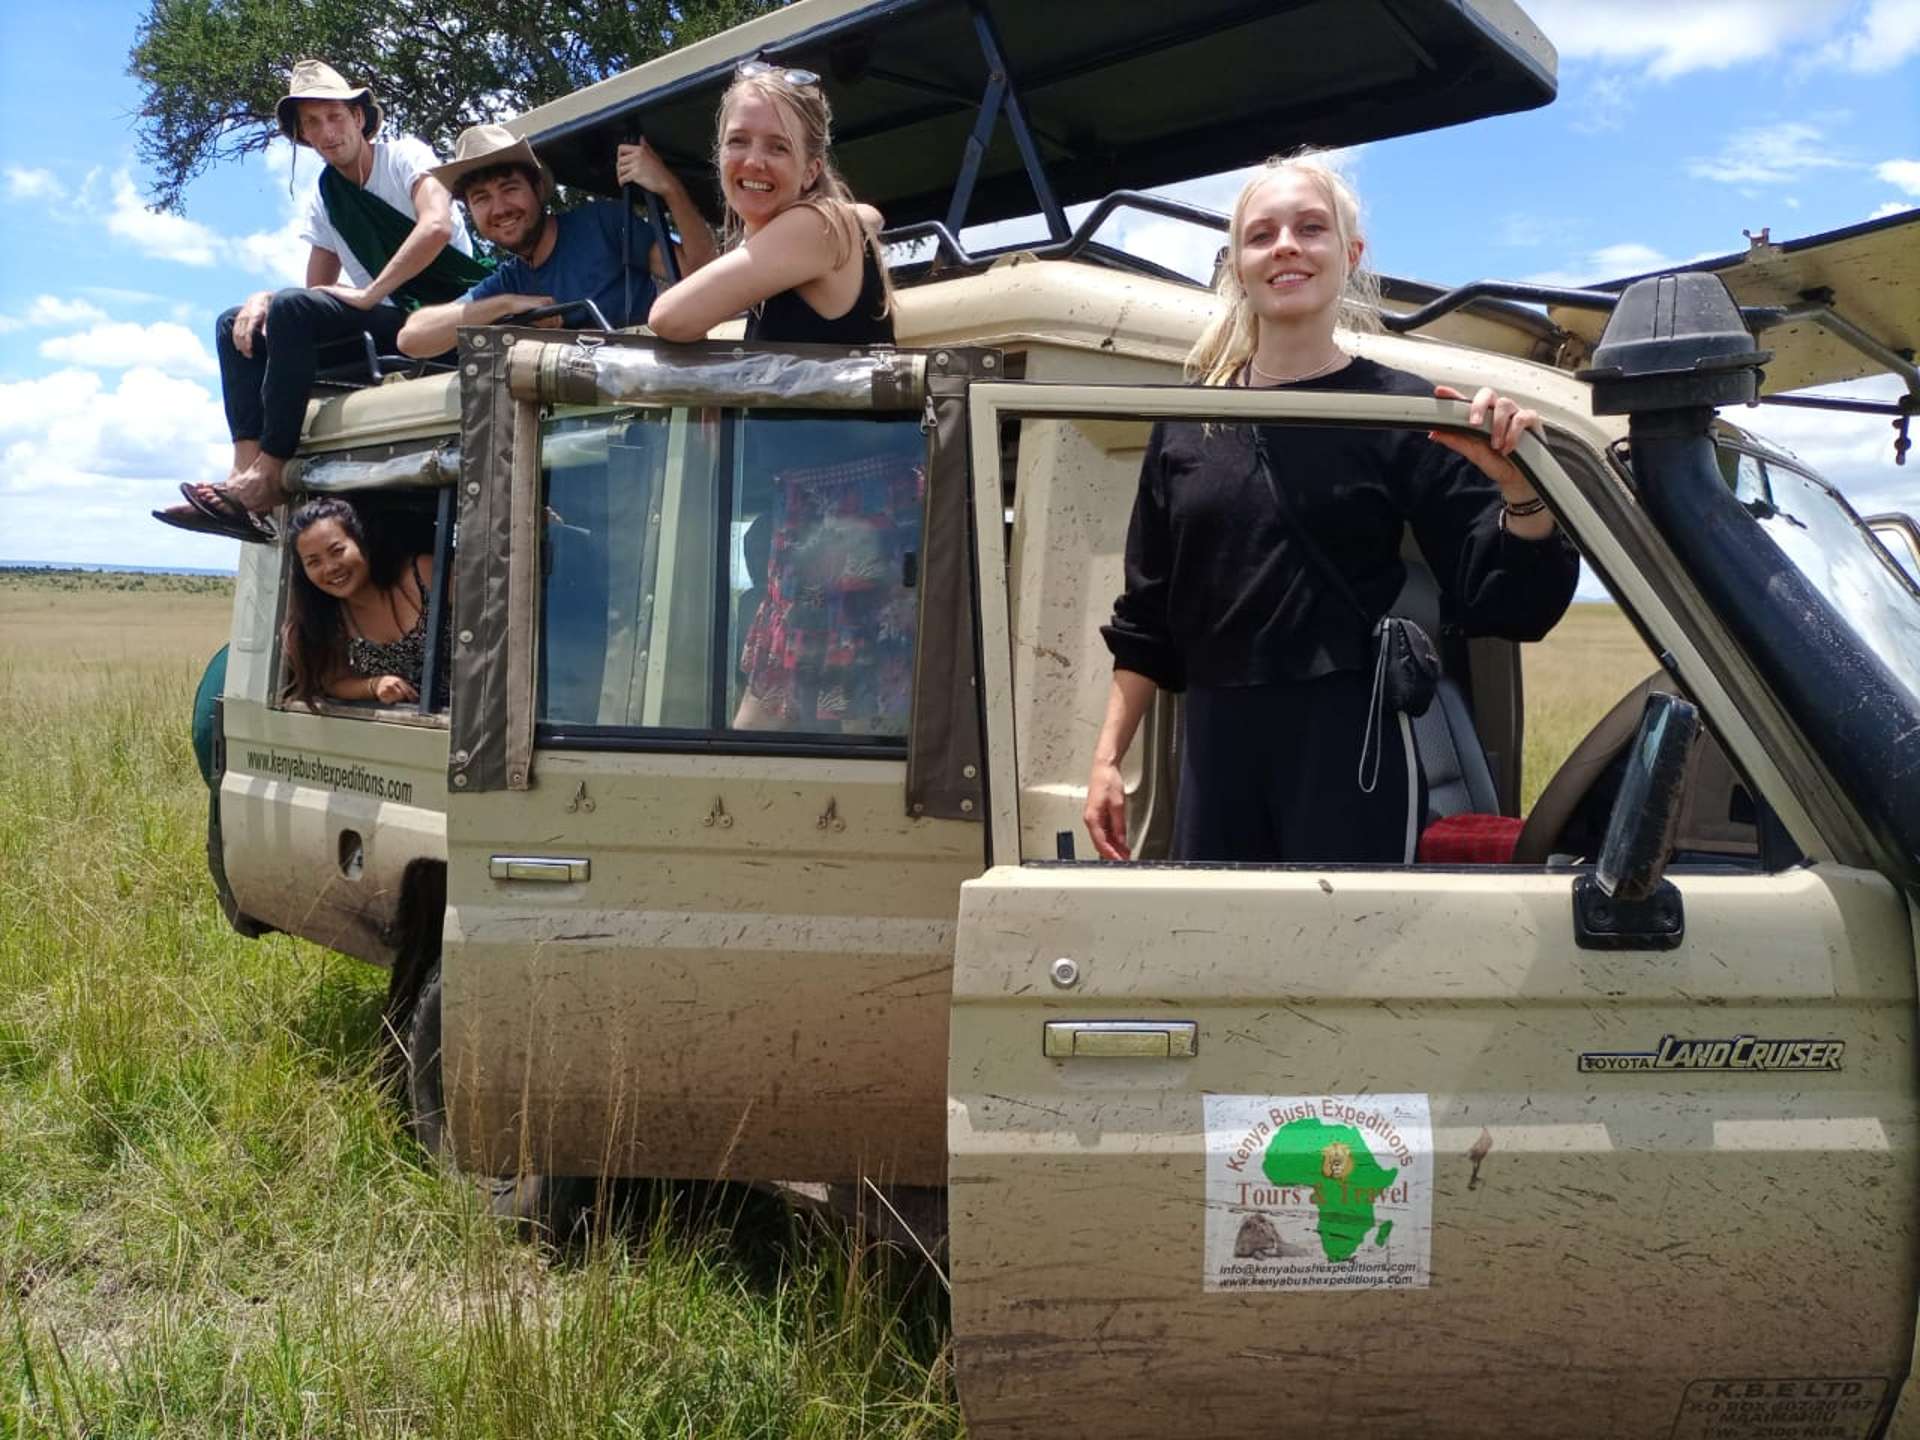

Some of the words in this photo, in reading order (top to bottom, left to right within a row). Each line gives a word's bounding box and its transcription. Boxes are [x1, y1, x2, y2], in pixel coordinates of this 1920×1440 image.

[247, 750, 413, 803] www.kenyabushexpeditions.com
[1584, 1057, 1650, 1069] TOYOTA
[1226, 1120, 1270, 1173] Kenya
[1269, 1101, 1316, 1127] Bush
[1322, 1099, 1413, 1168] Expeditions
[1235, 1182, 1302, 1205] Tours
[1339, 1182, 1409, 1204] Travel
[1219, 1262, 1416, 1277] info@kenyabushexpeditions.com
[1219, 1275, 1413, 1288] www.kenyabushexpeditions.com
[1804, 1382, 1863, 1397] LTD
